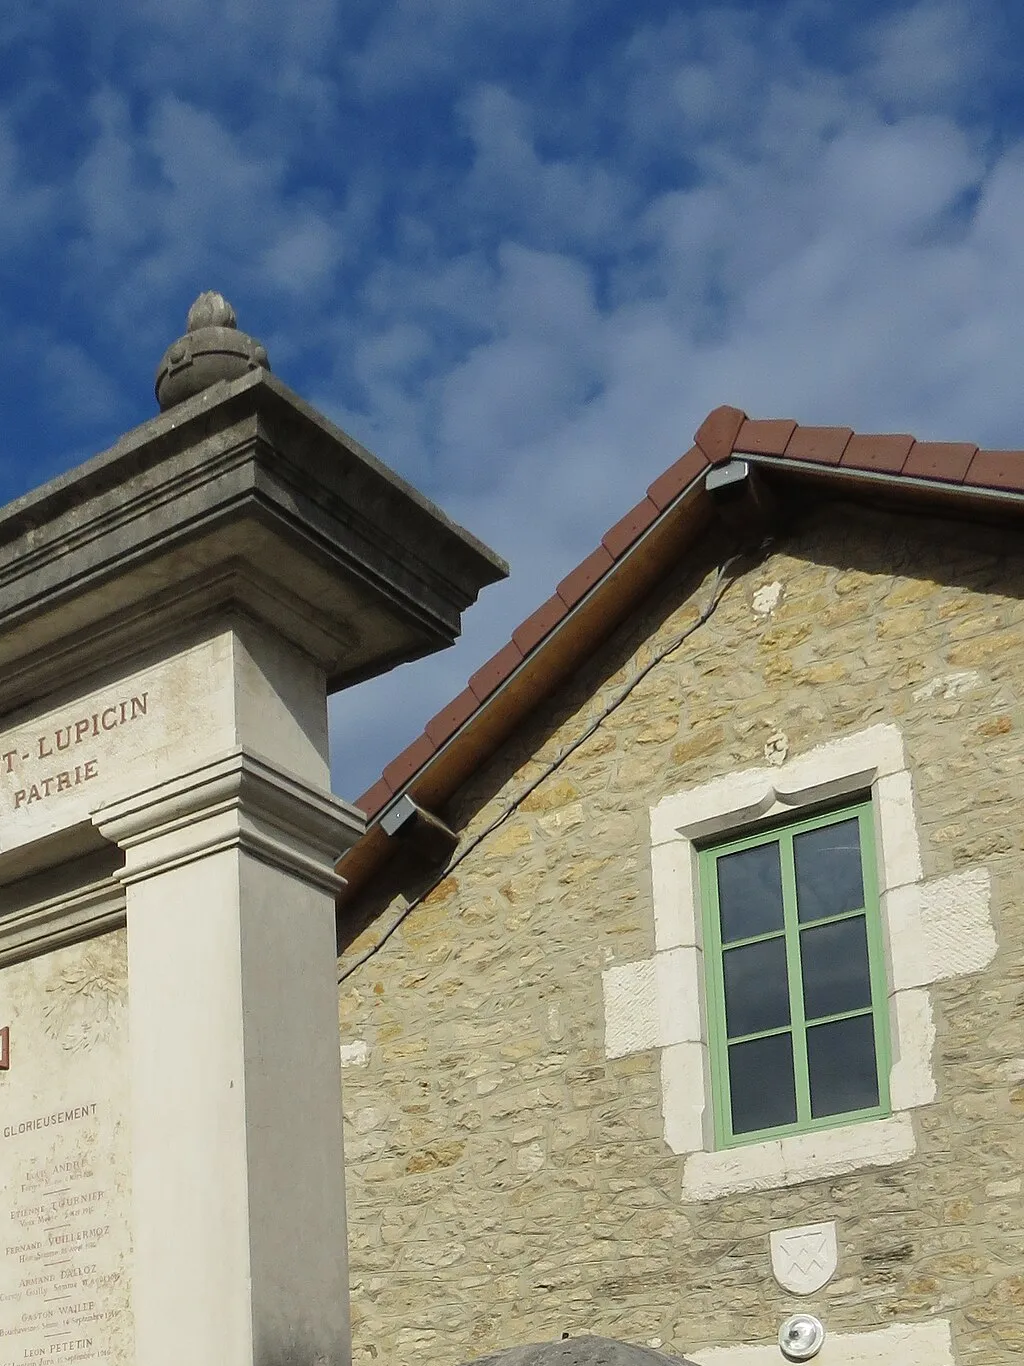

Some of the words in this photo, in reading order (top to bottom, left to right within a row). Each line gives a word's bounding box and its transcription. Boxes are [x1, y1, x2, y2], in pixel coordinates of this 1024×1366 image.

[14, 758, 99, 809] PATRIE
[3, 1103, 98, 1138] GLORIEUSEMENT
[6, 1242, 42, 1255] FERNAND
[48, 1226, 110, 1245] VUILLERMOZ
[19, 1276, 55, 1288] ARMAND
[60, 1265, 97, 1279] DALLOZ
[22, 1311, 54, 1322] GASTON
[50, 1339, 93, 1353] PETETIN
